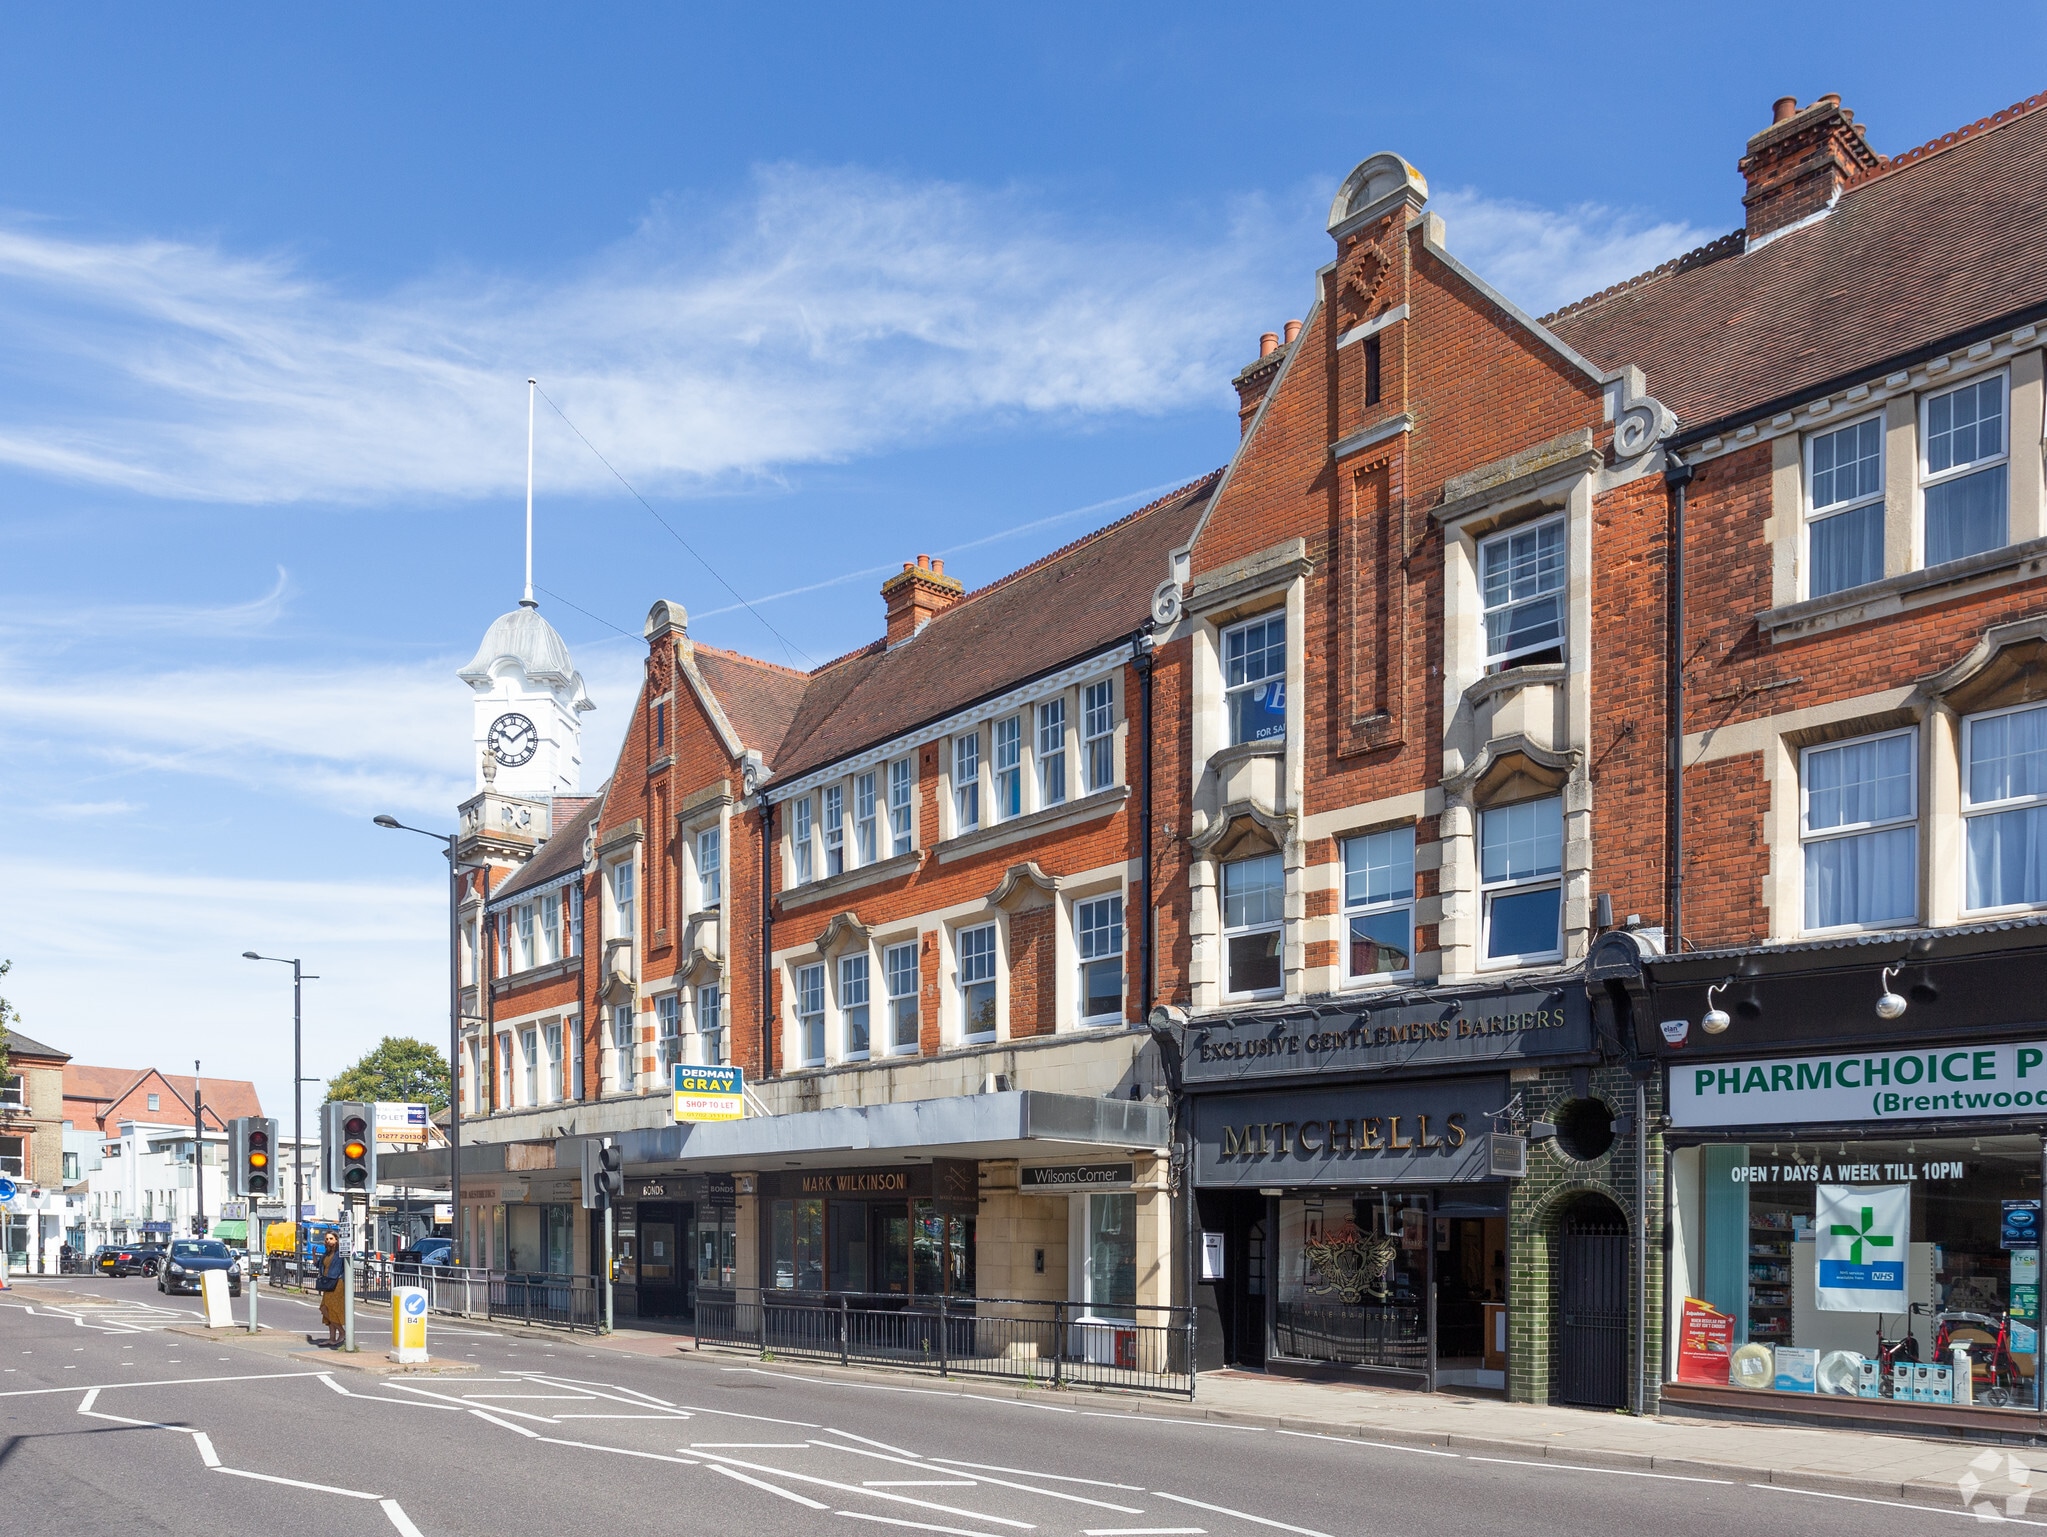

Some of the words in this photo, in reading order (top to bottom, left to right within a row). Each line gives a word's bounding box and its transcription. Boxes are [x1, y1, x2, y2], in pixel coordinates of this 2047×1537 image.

[1257, 727, 1271, 738] FOR
[1201, 1035, 1300, 1060] EXCLUSIVE
[1307, 1020, 1450, 1050] GENTLEMENS
[1459, 1008, 1565, 1037] BARBERS
[682, 1068, 734, 1079] DEDMAN
[1695, 1050, 1997, 1096] PHARMCHOICE
[682, 1078, 733, 1091] GRAY
[686, 1100, 707, 1108] SHOP
[1221, 1112, 1467, 1156] MITCHELLS
[1034, 1169, 1076, 1184] Wilsons
[1077, 1167, 1118, 1182] Corner
[1731, 1166, 1768, 1183] OPEN
[1771, 1166, 1779, 1182] 7
[1783, 1165, 1818, 1182] DAYS
[1822, 1165, 1833, 1181] A
[1837, 1164, 1881, 1181] WEEK
[1884, 1163, 1918, 1181] TILL
[1922, 1161, 1964, 1180] 10PM
[802, 1175, 833, 1192] MARK
[836, 1172, 906, 1192] WILKINSON
[469, 1189, 496, 1199] AESTHETICS
[643, 1185, 664, 1196] BONDS
[710, 1185, 734, 1193] BONDS
[1872, 1272, 1894, 1280] NHS
[1341, 1312, 1396, 1323] BARBERS
